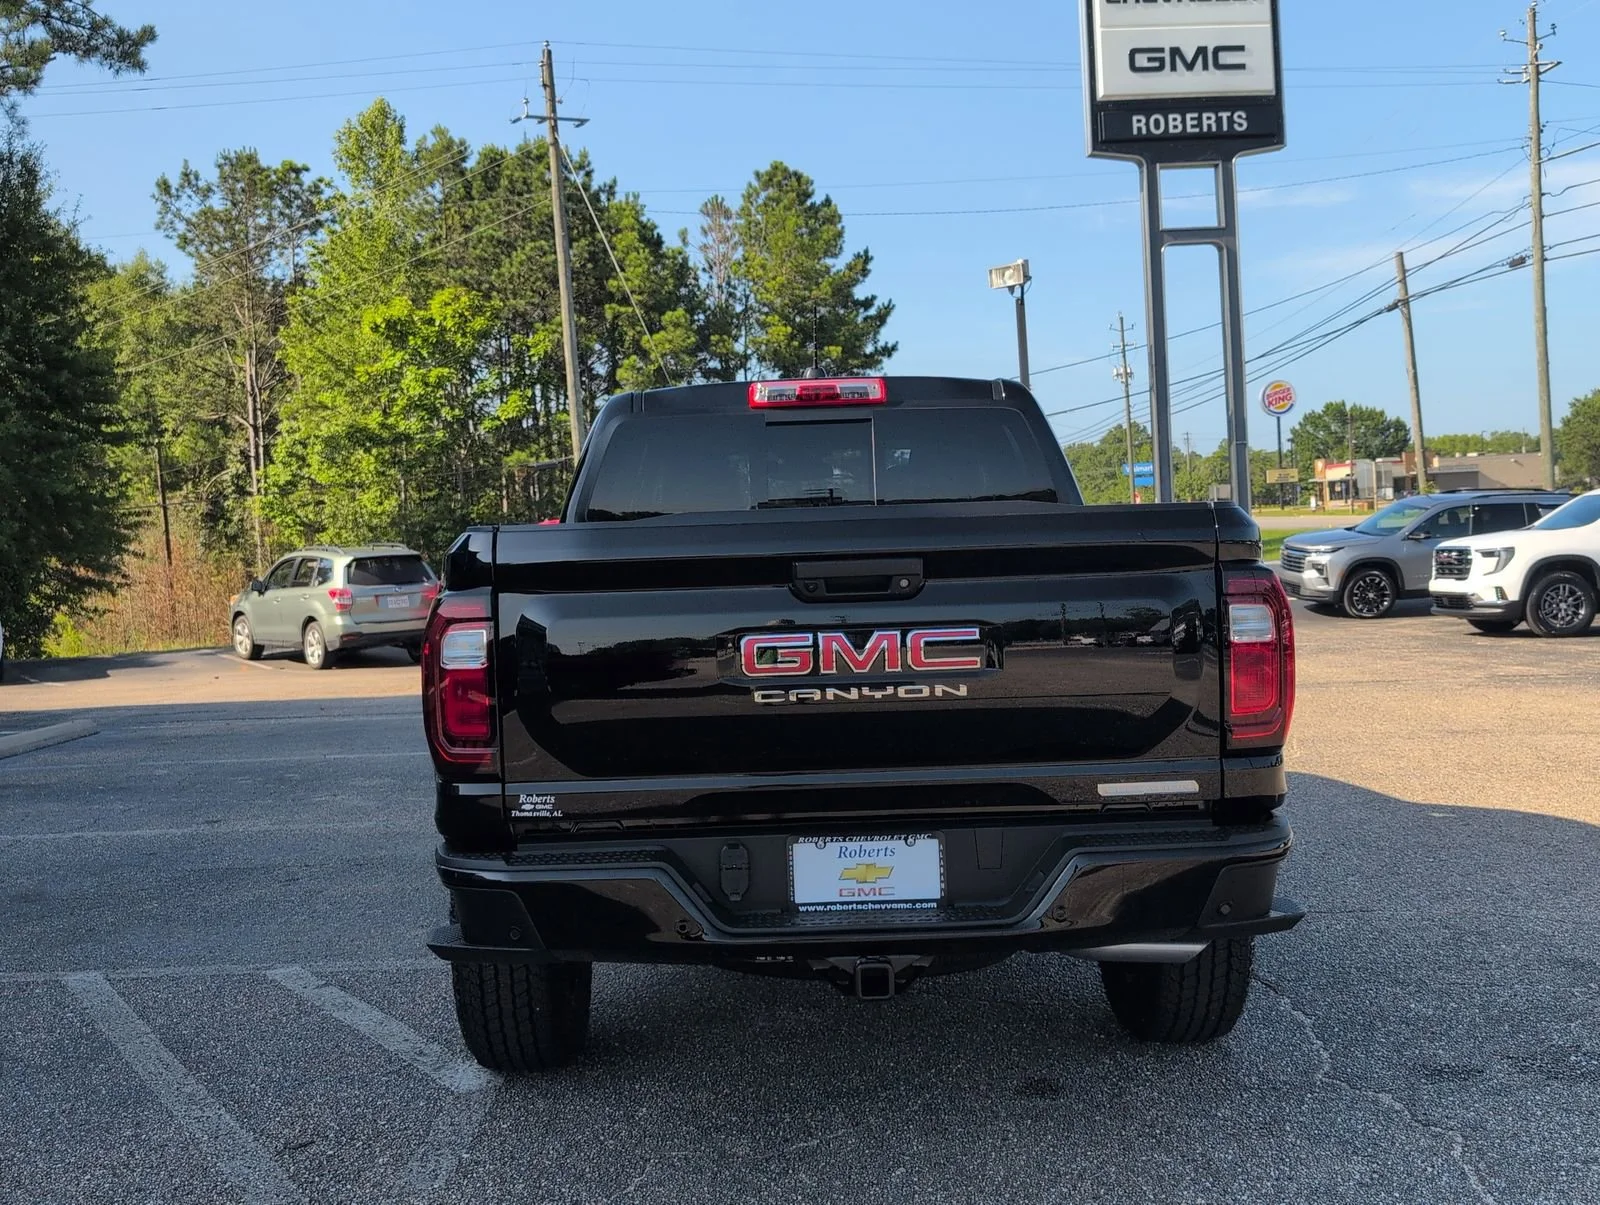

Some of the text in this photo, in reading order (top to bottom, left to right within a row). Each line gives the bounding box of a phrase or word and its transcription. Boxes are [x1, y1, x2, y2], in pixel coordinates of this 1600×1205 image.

[1128, 45, 1246, 74] GMC
[1132, 111, 1249, 136] ROBERTS
[1266, 386, 1291, 400] BURGER
[1268, 392, 1292, 407] KING
[741, 628, 981, 677] GMC
[754, 684, 968, 703] CANYON
[519, 794, 556, 803] Roberts
[798, 833, 932, 844] ROBERTS CHEVROLET GMC
[837, 844, 896, 859] Roberts
[839, 887, 895, 898] GMC
